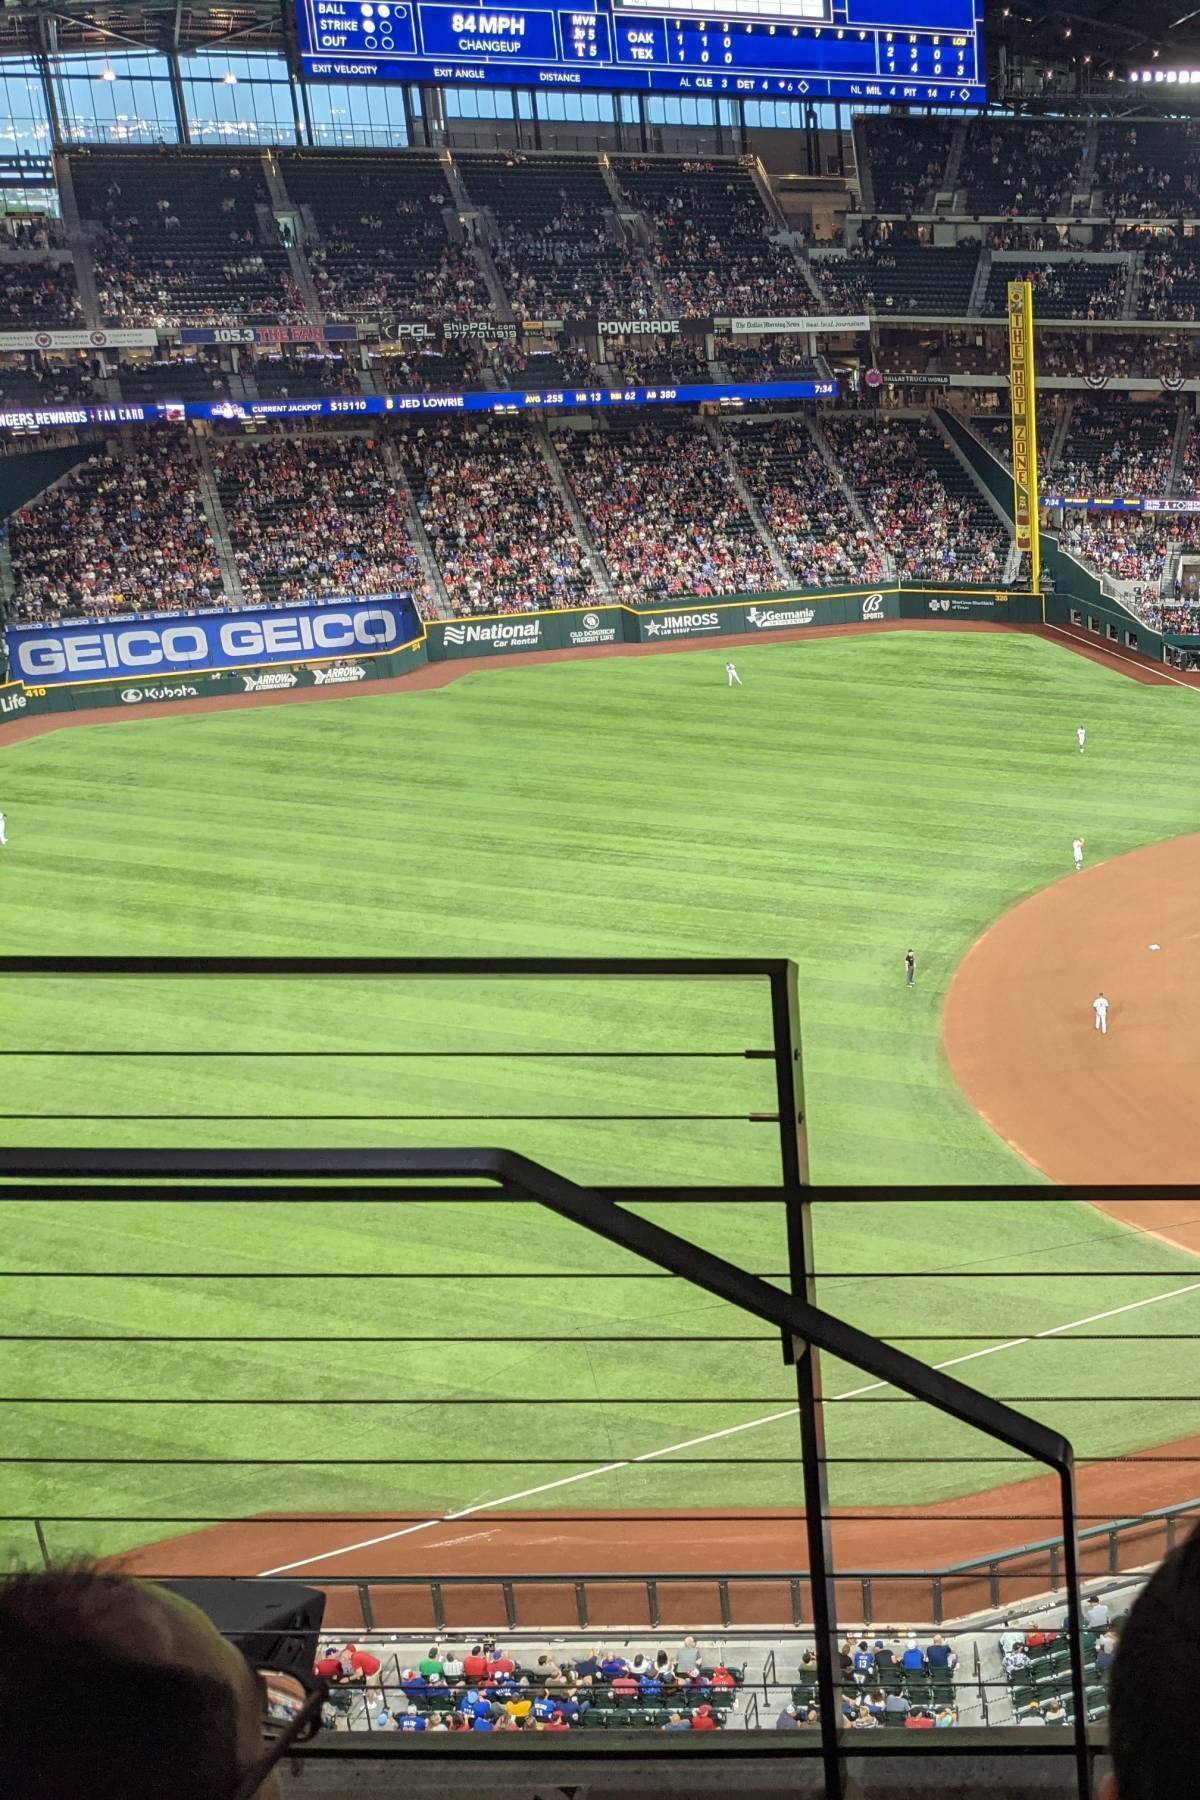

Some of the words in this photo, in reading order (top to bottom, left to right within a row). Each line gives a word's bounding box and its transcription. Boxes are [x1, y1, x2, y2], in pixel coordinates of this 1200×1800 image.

[318, 4, 346, 15] BALL
[320, 20, 358, 32] STRIKE
[452, 15, 476, 33] 84
[479, 17, 525, 36] MPH
[572, 15, 596, 26] MVR
[588, 30, 595, 40] 5
[676, 21, 681, 29] 1
[700, 22, 705, 31] 2
[723, 23, 729, 32] 3
[746, 25, 752, 34] 4
[792, 27, 798, 36] 6
[815, 28, 821, 38] 7
[859, 31, 866, 40] 9
[886, 33, 893, 42] R
[909, 35, 916, 43] H
[933, 36, 939, 45] E
[952, 38, 967, 46] LOB
[322, 36, 347, 47] OUT
[459, 39, 521, 53] CHANGEUP
[627, 32, 654, 44] OAK
[678, 34, 683, 45] 1
[701, 36, 707, 47] 1
[723, 37, 731, 48] 0
[887, 47, 894, 57] 2
[910, 48, 918, 59] 3
[934, 49, 941, 60] 0
[958, 50, 964, 61] 1
[589, 46, 597, 57] 5
[630, 48, 654, 60] TEX
[678, 50, 684, 61] 1
[701, 52, 709, 63] 0
[724, 52, 732, 64] 0
[889, 61, 895, 72] 1
[911, 63, 918, 74] 4
[934, 63, 941, 74] 0
[957, 65, 964, 76] 3
[312, 64, 332, 73] EXIT
[334, 65, 378, 74] VELOCITY
[434, 68, 454, 78] EXIT
[455, 70, 485, 79] ANGLE
[539, 72, 581, 83] DISTANCE
[680, 78, 691, 87] AL
[695, 78, 713, 88] CLE
[721, 79, 728, 88] 3
[736, 80, 755, 90] DET
[761, 81, 768, 90] 4
[787, 83, 793, 91] 6
[850, 86, 862, 95] NL
[866, 86, 882, 96] MIL
[889, 86, 896, 96] 4
[904, 87, 917, 97] PIT
[927, 89, 937, 98] 14
[950, 91, 956, 99] F
[398, 323, 436, 337] PGL
[443, 322, 517, 332] ShipPGL.com
[597, 320, 680, 334] POWERADE
[746, 321, 763, 329] Dallas
[763, 321, 786, 329] Morning
[786, 320, 800, 328] News
[213, 329, 255, 342] 105.3
[256, 328, 289, 341] THE
[291, 326, 324, 340] FAN
[444, 331, 517, 339] 877.701.1919
[1012, 314, 1024, 359] THE
[659, 390, 676, 399] 380
[814, 384, 833, 394] 7:34
[1014, 371, 1025, 415] HOT
[525, 395, 541, 404] AVG
[543, 393, 563, 403] .255
[590, 392, 601, 401] 13
[624, 392, 636, 400] 62
[252, 405, 287, 414] CURRENT
[288, 403, 322, 412] JACKPOT
[330, 401, 367, 411] $15110
[399, 399, 420, 409] JED
[422, 397, 465, 408] LOWRIE
[35, 409, 88, 425] REWARDS
[97, 410, 117, 421] FAN
[118, 408, 145, 421] CARD
[1016, 426, 1025, 484] ZONE
[16, 623, 43, 631] GEICO
[62, 619, 89, 627] GEICO
[108, 615, 135, 623] GEICO
[153, 611, 180, 619] GEICO
[242, 604, 267, 612] GEICO
[285, 600, 310, 608] GEICO
[369, 593, 393, 601] GEICO
[766, 608, 815, 621] Germania
[863, 611, 884, 621] SPORTS
[466, 619, 538, 642] National
[570, 630, 583, 638] OLD
[583, 628, 616, 637] DOMINION
[18, 626, 209, 676] GEICO
[220, 610, 397, 657] GEICO
[493, 640, 509, 648] Car
[510, 636, 538, 646] Rental
[572, 635, 599, 644] FREIGHT
[326, 667, 359, 678] ARROW
[257, 673, 289, 685] ARROW
[25, 688, 47, 697] 410
[145, 684, 198, 700] Kubota
[1, 695, 27, 713] Life
[858, 1660, 867, 1669] 13
